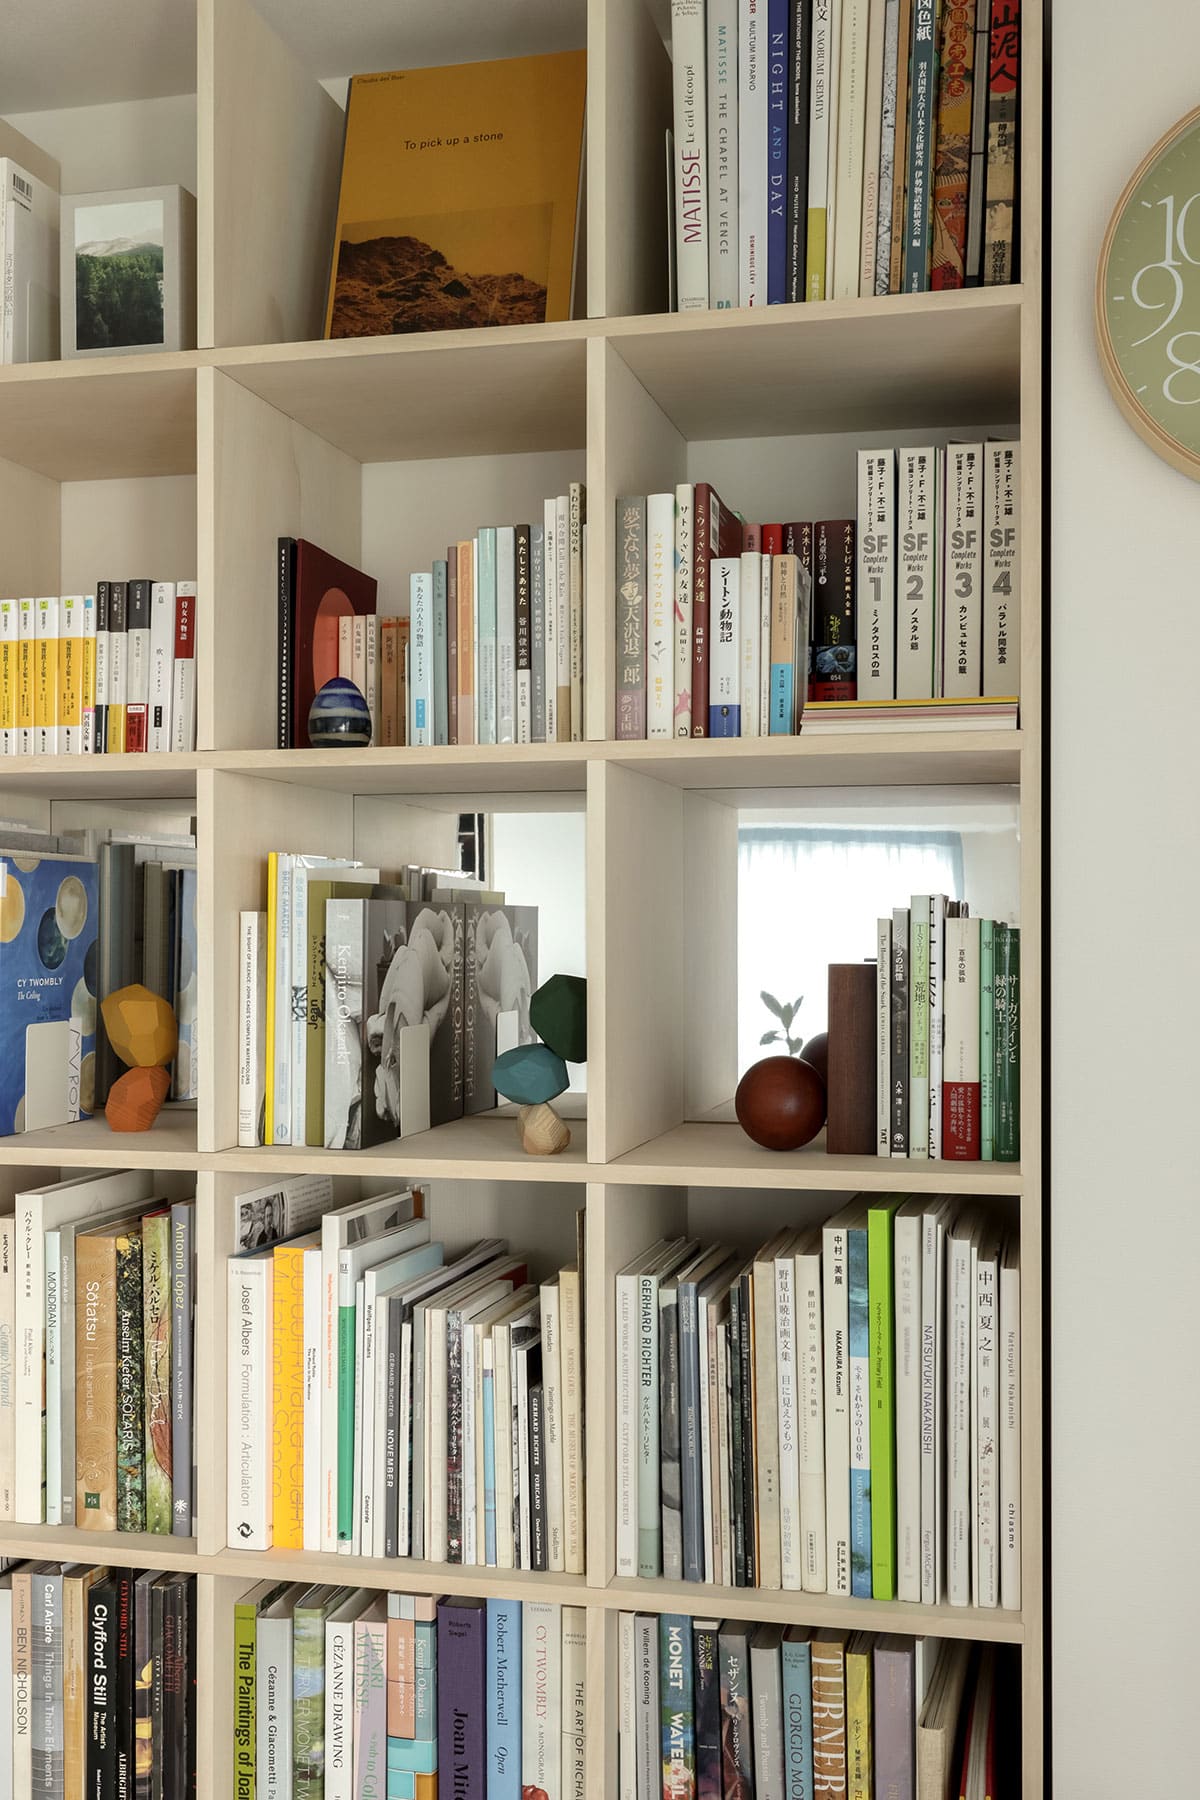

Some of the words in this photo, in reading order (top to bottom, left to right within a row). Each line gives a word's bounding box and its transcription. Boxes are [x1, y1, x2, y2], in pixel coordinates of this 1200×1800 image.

[718, 25, 728, 84] MATISSE
[771, 32, 784, 111] NIGHT
[814, 29, 826, 76] NAOBUMI
[718, 94, 729, 119] THE
[814, 78, 824, 121] SEIMIYA
[403, 140, 417, 151] To
[420, 137, 443, 152] pick
[446, 137, 460, 148] up
[463, 136, 470, 144] a
[473, 131, 504, 144] stone
[719, 127, 730, 179] CHAPEL
[771, 125, 783, 160] AND
[682, 149, 702, 244] MATISSE
[719, 188, 730, 205] AT
[771, 174, 783, 217] DAY
[865, 171, 876, 228] GAGOSIAN
[719, 211, 730, 255] VENCE
[863, 231, 874, 282] GALLERY
[1130, 263, 1184, 347] 9
[623, 506, 642, 581] 夢でない夢
[695, 504, 705, 603] ミウラさんの友達
[863, 534, 889, 555] SF
[902, 532, 929, 553] SF
[902, 550, 928, 563] Complete
[950, 529, 977, 550] SF
[950, 547, 977, 560] Complete
[989, 527, 1016, 548] SF
[989, 545, 1016, 559] Complete
[518, 536, 527, 606] あたしとあなた
[862, 553, 888, 565] Complete
[867, 564, 884, 574] Works
[906, 562, 924, 573] Works
[954, 559, 972, 570] Works
[994, 557, 1012, 568] Works
[869, 577, 882, 602] 1
[905, 574, 924, 601] 2
[953, 572, 973, 599] 3
[991, 570, 1012, 596] 4
[416, 586, 425, 649] あなたの人生の物語
[719, 566, 733, 643] シートン動物記
[519, 616, 528, 668] 谷川俊太郎
[623, 606, 642, 685] 天沢退二郎
[695, 627, 705, 664] 益田ミリ
[996, 603, 1007, 665] パラレル同窓会
[335, 943, 352, 1000] Kenjiro
[452, 918, 464, 1001] Kenjiro
[17, 977, 28, 987] CY
[29, 976, 64, 987] TWOMBLY
[17, 990, 26, 1001] The
[308, 999, 319, 1031] Jean
[337, 1004, 351, 1066] Okazaki
[453, 1006, 464, 1102] Okazaki
[174, 1222, 187, 1270] Antonio
[833, 1235, 843, 1285] 中村一美展
[47, 1271, 57, 1328] MONDRIAN
[172, 1273, 187, 1310] López
[241, 1284, 253, 1317] Josef
[621, 1291, 630, 1322] ALLIED
[641, 1279, 653, 1334] GERHARD
[121, 1308, 133, 1353] Anselm
[365, 1304, 373, 1331] Wolfgang
[778, 1269, 792, 1363] 野見山暁治画文集
[241, 1318, 253, 1356] Albers
[621, 1323, 630, 1351] WORKS
[835, 1330, 844, 1370] NAKAMURA
[922, 1325, 934, 1389] NATSUYUKI
[1006, 1331, 1016, 1378] Natsuyuki
[122, 1355, 134, 1390] Kiefer
[641, 1337, 653, 1387] RICHTER
[241, 1363, 253, 1431] Formulation
[621, 1352, 630, 1416] ARCHITECTURE
[834, 1370, 844, 1397] Kazumi
[122, 1394, 135, 1451] SOLARIS
[781, 1375, 793, 1452] 目に見えるもの
[922, 1391, 934, 1455] NAKANISHI
[1007, 1383, 1016, 1430] Nakanishi
[386, 1429, 394, 1489] NOVEMBER
[621, 1422, 630, 1464] CLYFFORD
[241, 1441, 253, 1507] Articulation
[622, 1465, 630, 1489] STILL
[363, 1495, 371, 1524] Concorde
[622, 1490, 630, 1526] MUSEUM
[1007, 1503, 1016, 1549] chiasme
[921, 1553, 933, 1588] McCaffrey
[44, 1583, 55, 1607] Carl
[17, 1627, 27, 1653] BEN
[44, 1609, 55, 1644] Andre
[92, 1603, 107, 1669] Clyfford
[119, 1631, 128, 1659] STILL
[496, 1613, 508, 1653] Robert
[535, 1625, 548, 1644] CY
[643, 1627, 651, 1656] Willem
[43, 1651, 55, 1689] Things
[164, 1614, 175, 1693] GIACOMETTI
[238, 1641, 254, 1671] The
[333, 1634, 346, 1700] CÉZANNE
[370, 1633, 384, 1689] HENRI
[415, 1639, 427, 1675] Kenjiro
[643, 1657, 651, 1669] de
[93, 1673, 107, 1706] Still
[173, 1654, 184, 1694] Alberto
[496, 1657, 508, 1726] Motherwell
[536, 1647, 547, 1720] TWOMBLY
[641, 1670, 651, 1705] Kooning
[17, 1657, 27, 1735] NICHOLSON
[44, 1691, 55, 1703] In
[235, 1675, 254, 1747] Paintings
[416, 1677, 427, 1719] Okazaki
[758, 1693, 768, 1731] Twombly
[44, 1705, 55, 1733] Their
[99, 1712, 107, 1725] The
[99, 1726, 107, 1750] Artist's
[332, 1702, 345, 1769] DRAWING
[789, 1693, 803, 1764] GIORGIO
[811, 1650, 846, 1793] TURNER
[238, 1751, 254, 1767] of
[494, 1745, 509, 1775] Open
[537, 1730, 545, 1784] MONOGRAPH
[760, 1733, 769, 1748] and
[44, 1736, 55, 1787] Elements
[760, 1749, 770, 1782] Poussin
